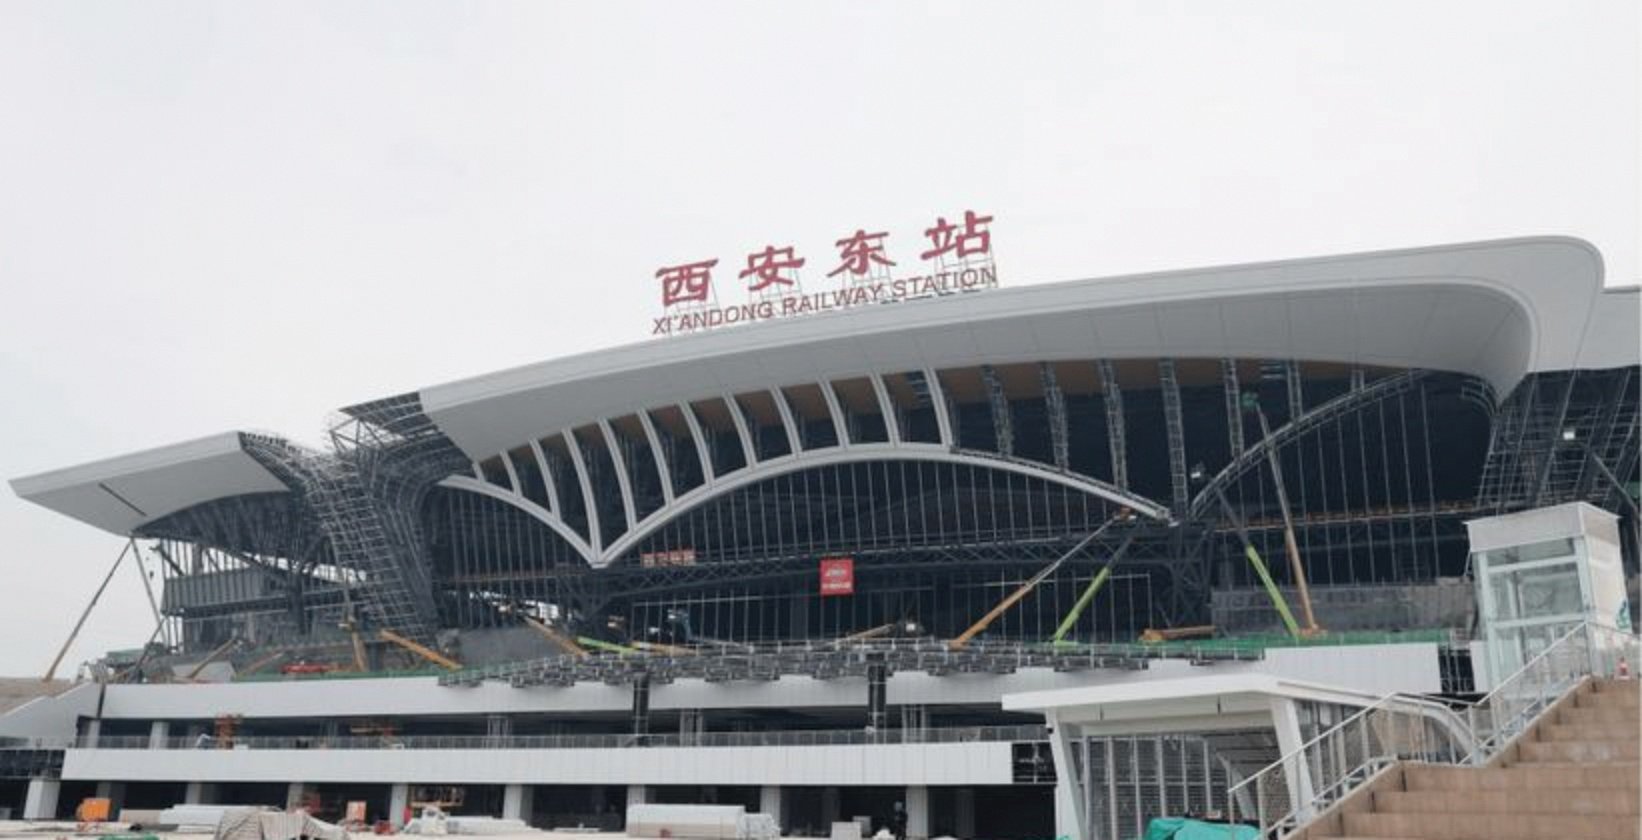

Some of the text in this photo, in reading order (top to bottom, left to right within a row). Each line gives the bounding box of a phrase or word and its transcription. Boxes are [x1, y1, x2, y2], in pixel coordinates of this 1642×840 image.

[655, 210, 994, 307] 西安东站
[653, 266, 998, 334] XI'ANDONG RAILWAY STATION
